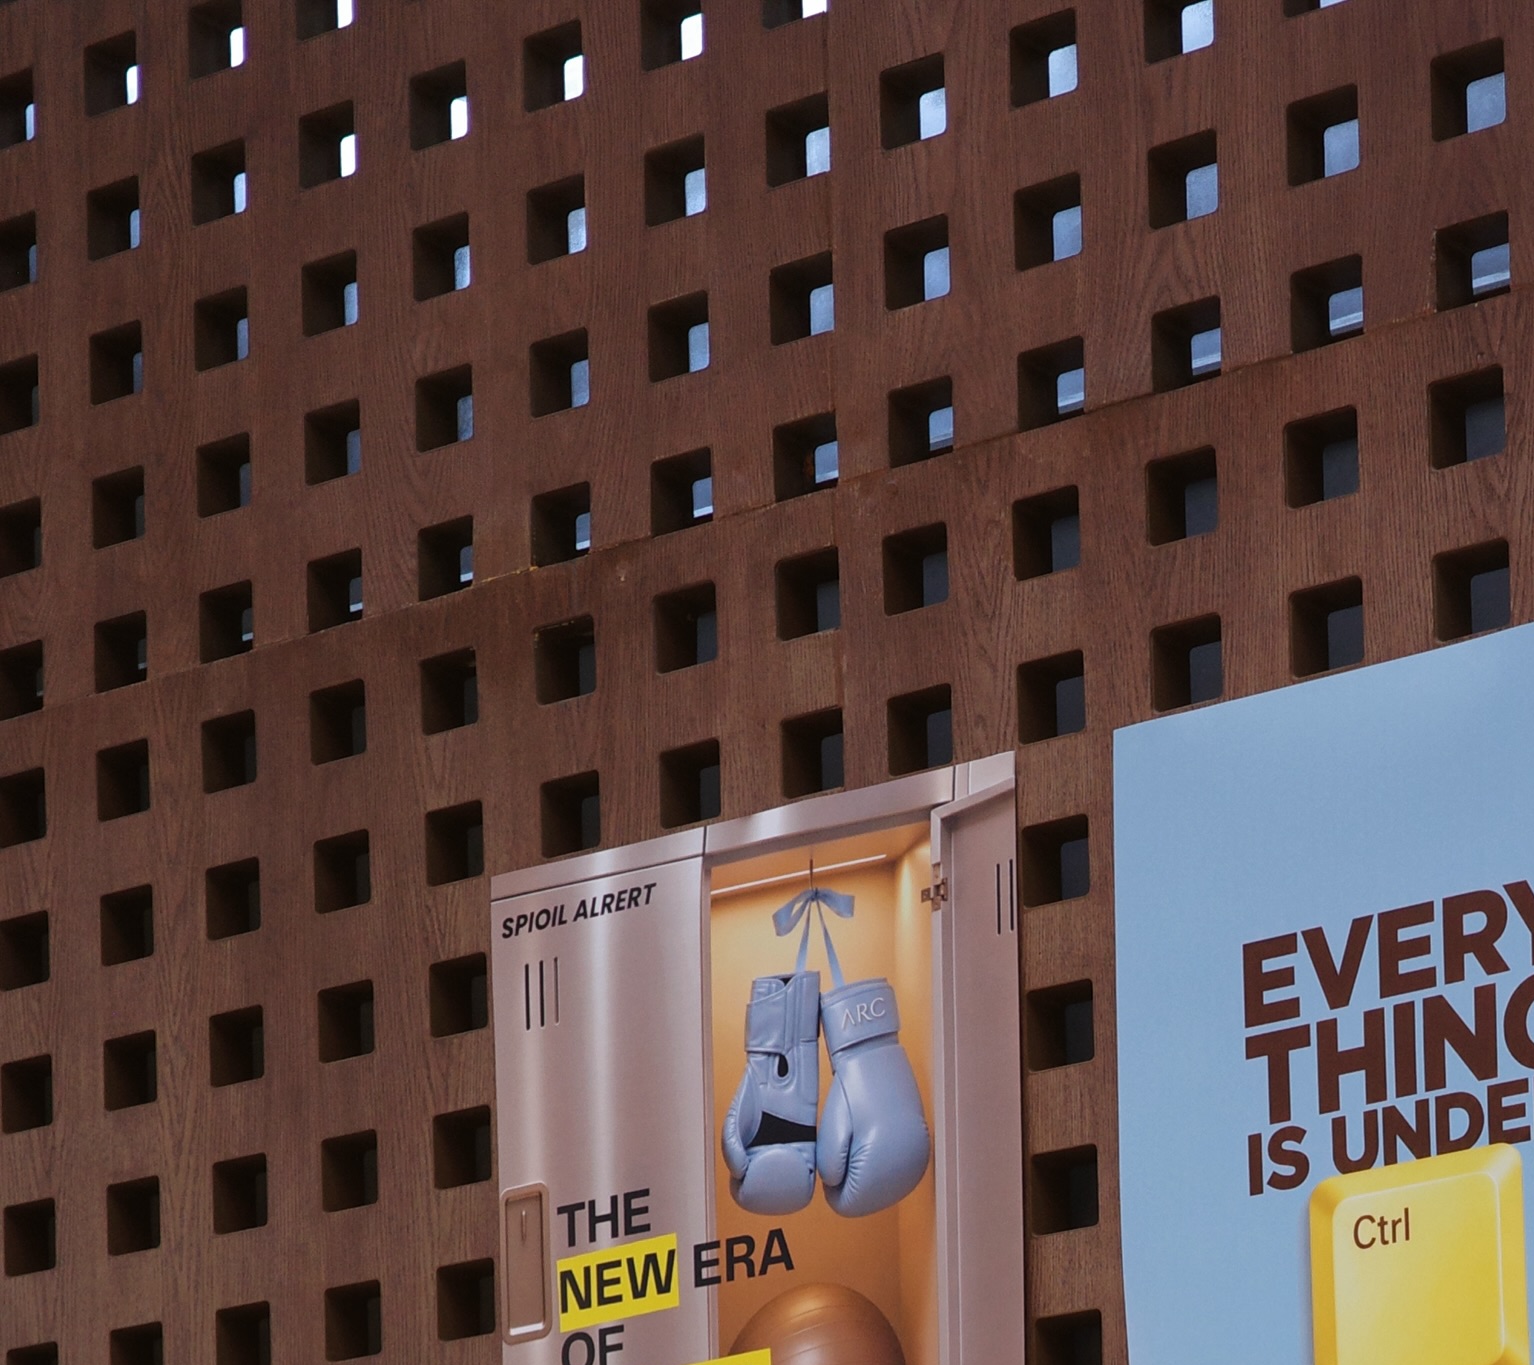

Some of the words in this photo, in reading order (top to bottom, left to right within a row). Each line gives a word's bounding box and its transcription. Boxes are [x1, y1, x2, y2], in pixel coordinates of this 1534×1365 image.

[502, 904, 567, 938] SPIOIL
[573, 882, 657, 922] ALRERT
[841, 997, 886, 1029] ARC
[1247, 1125, 1310, 1197] IS
[557, 1188, 651, 1247] THE
[1353, 1207, 1410, 1250] Ctrl
[560, 1249, 676, 1314] NEW
[693, 1228, 795, 1288] ERA
